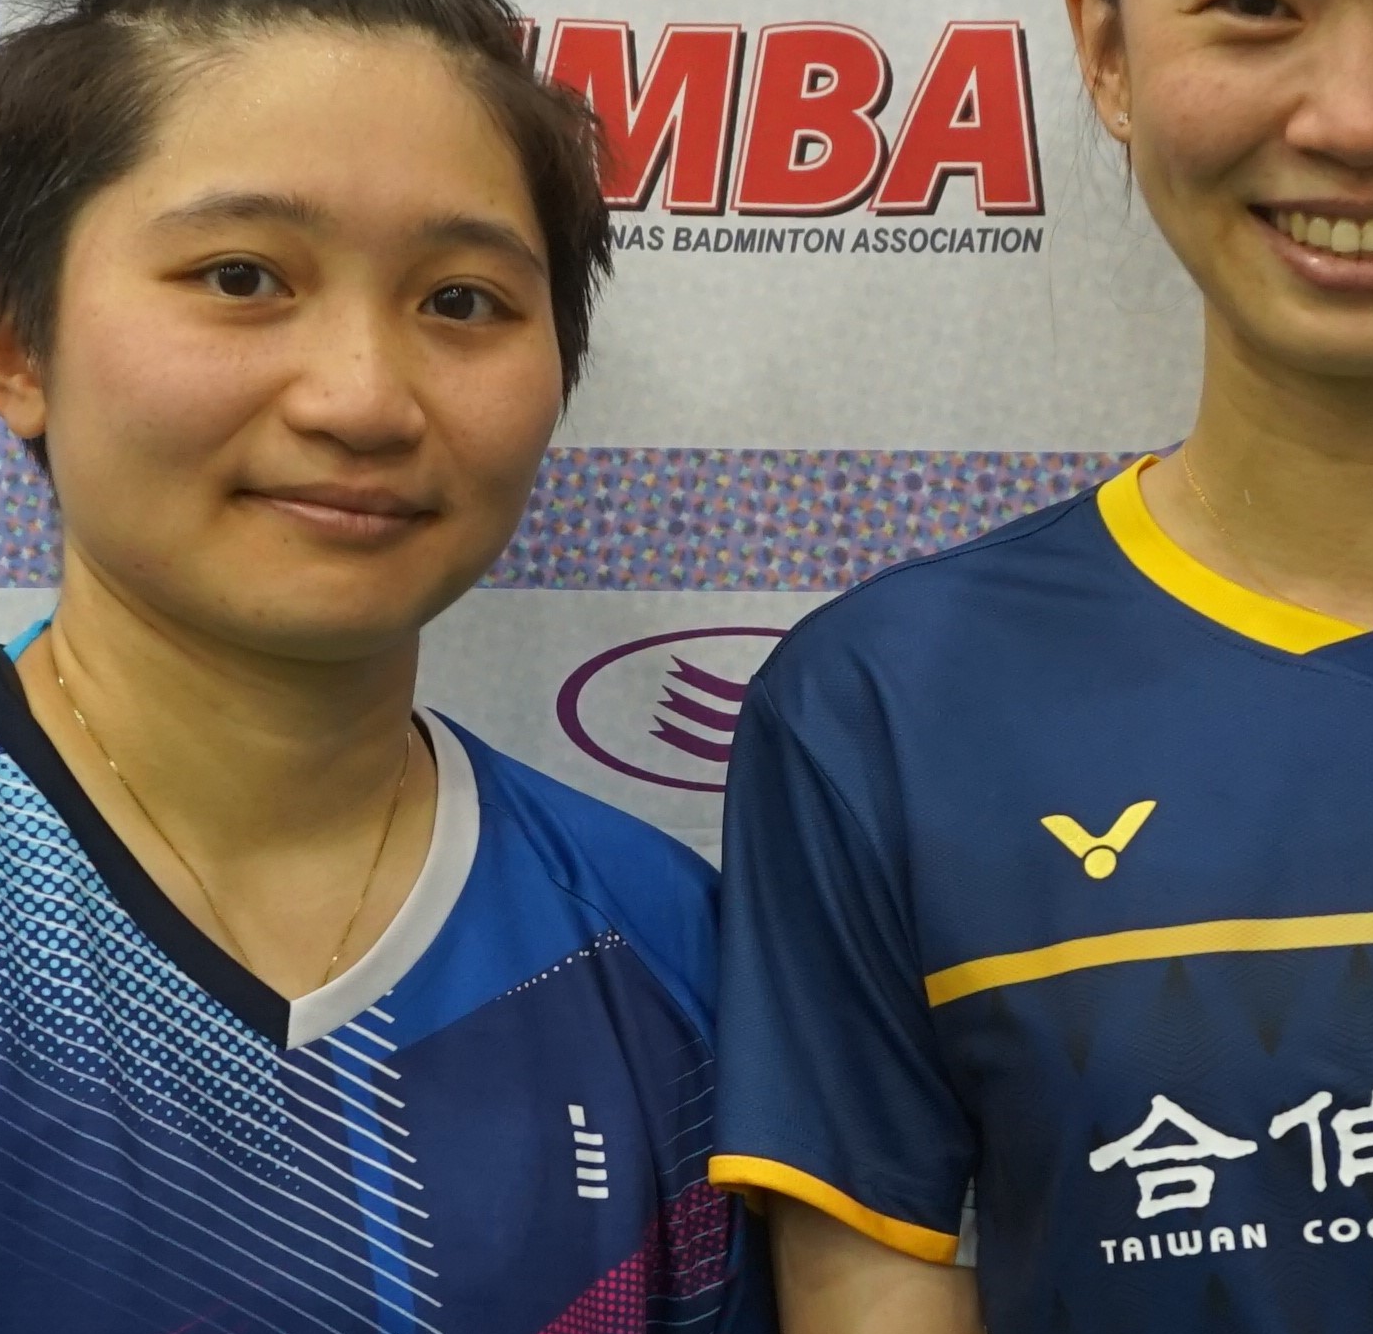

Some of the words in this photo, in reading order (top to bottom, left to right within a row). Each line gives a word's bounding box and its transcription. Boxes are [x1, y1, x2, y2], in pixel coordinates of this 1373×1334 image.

[510, 17, 1045, 217] MBA
[672, 225, 843, 254] BADMINTON
[851, 226, 1044, 254] ASSOCIATION
[1101, 1223, 1268, 1265] TAIWAN
